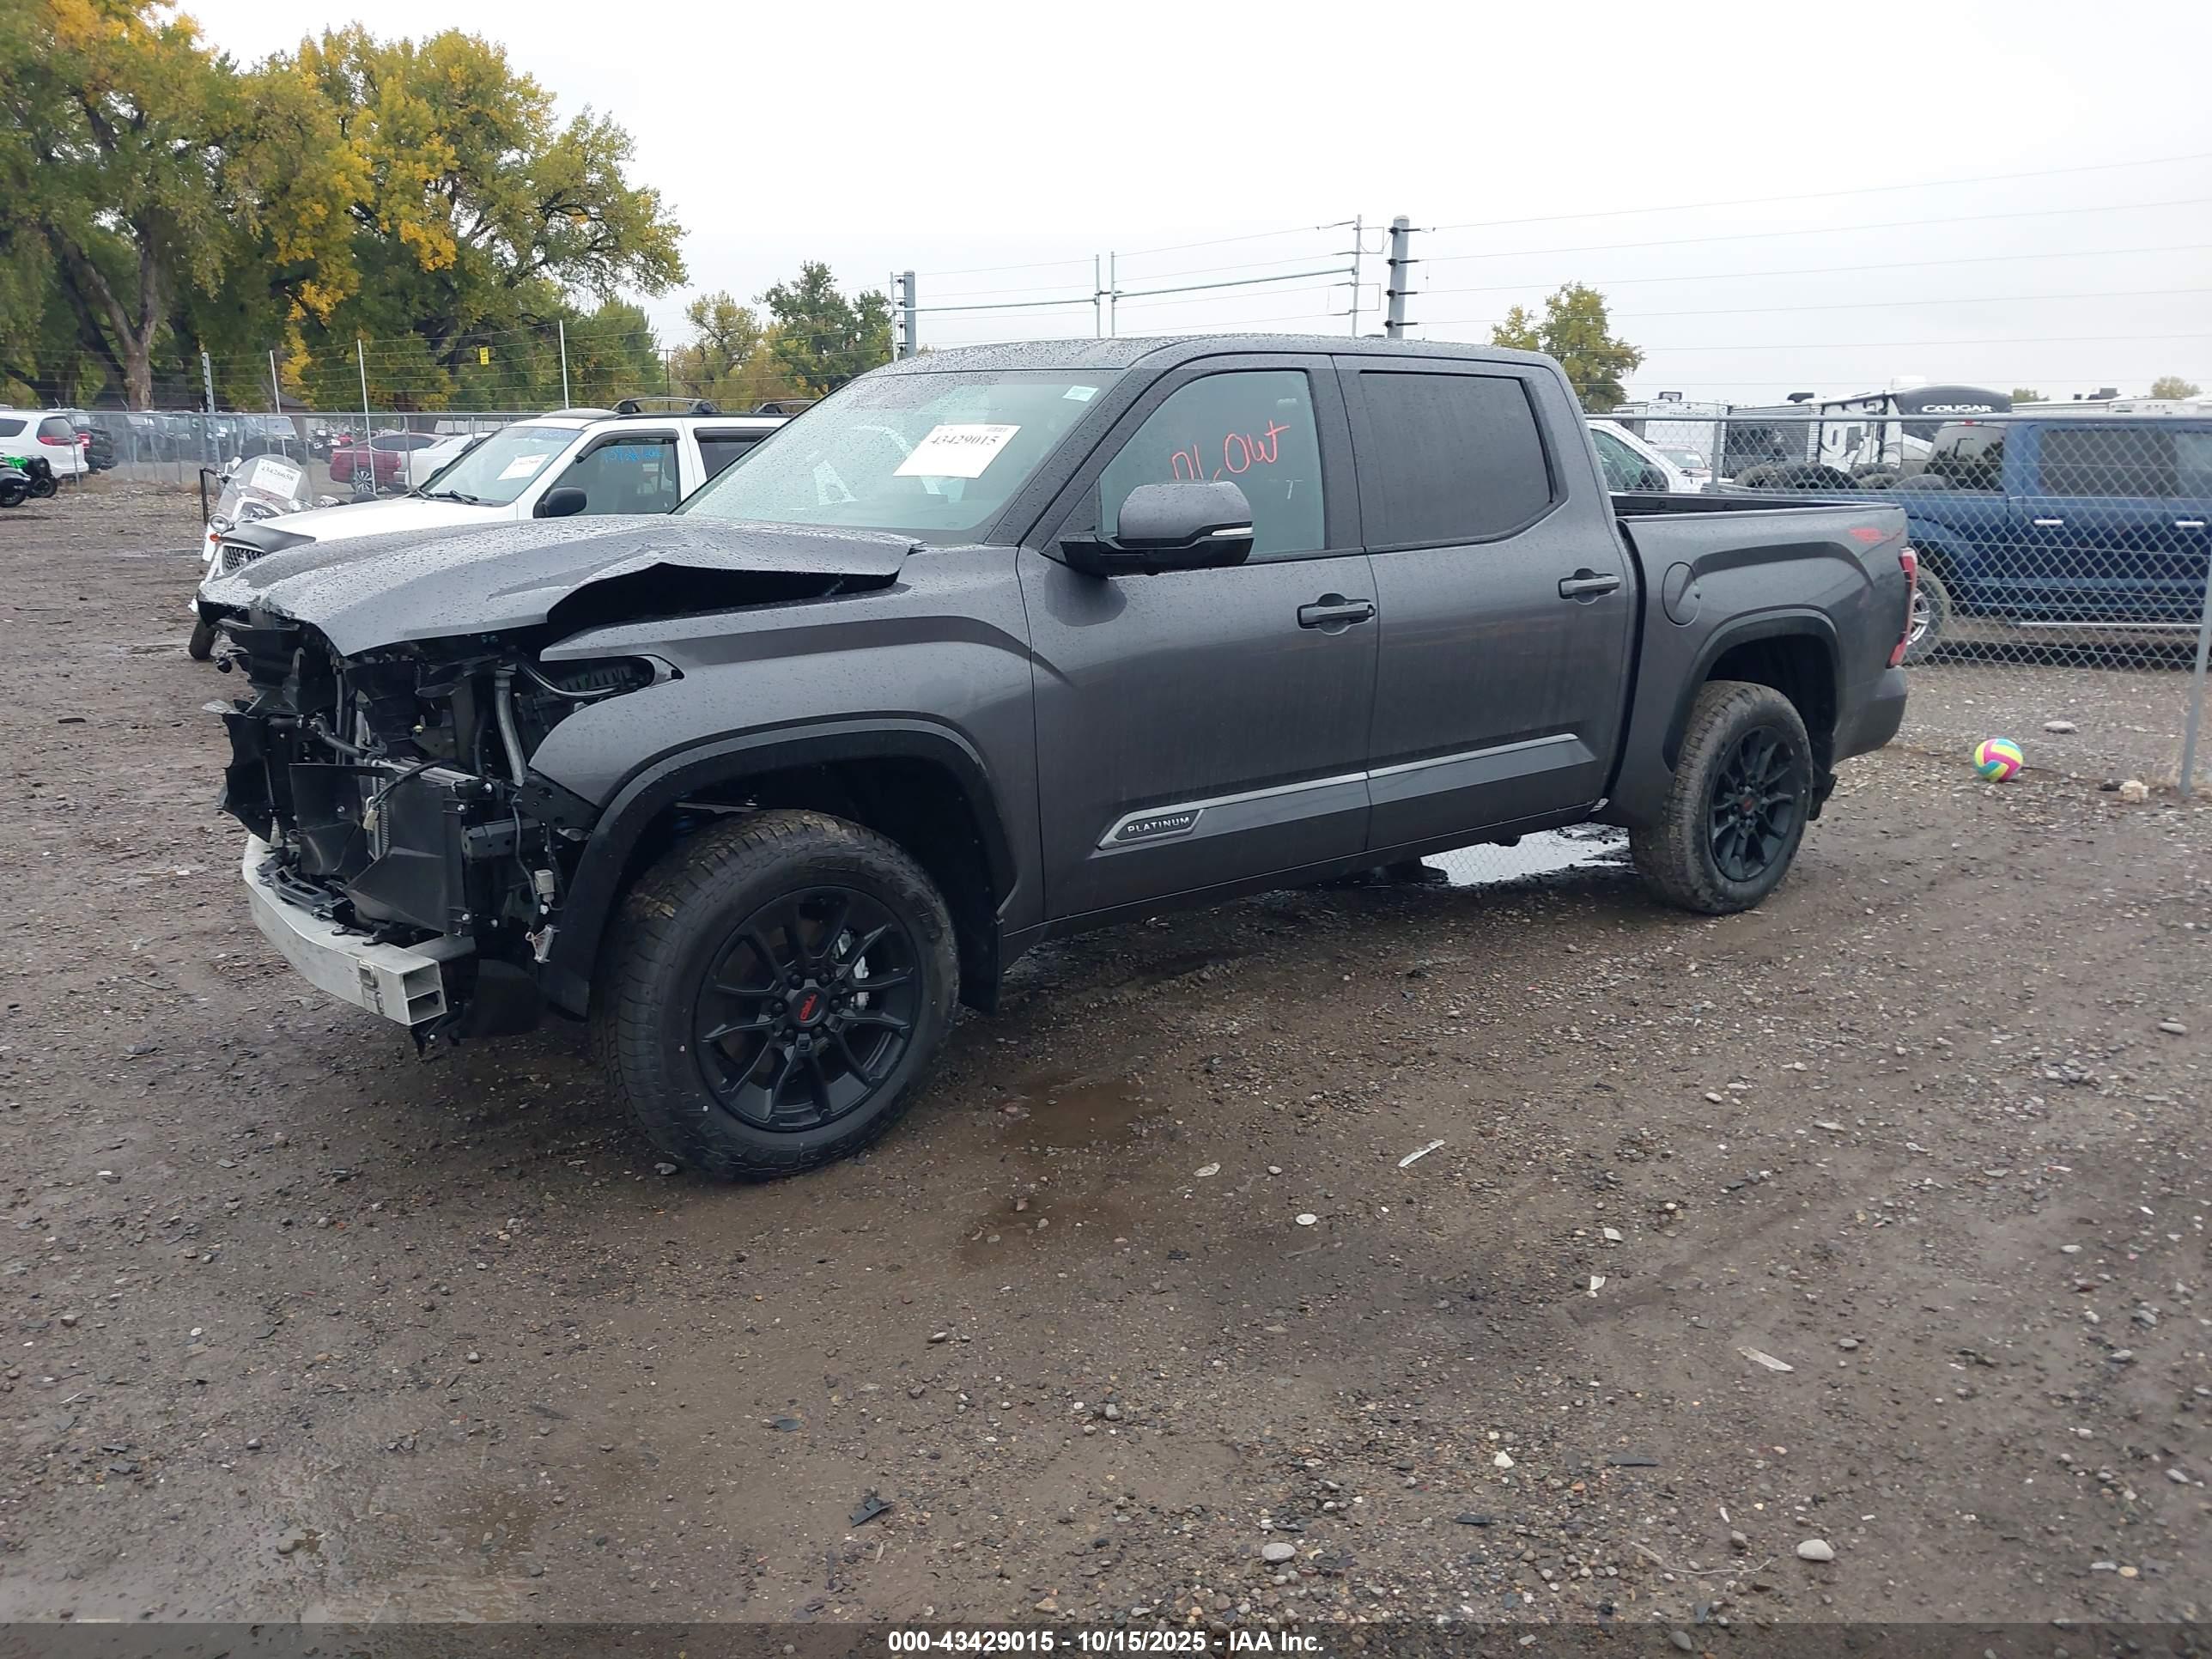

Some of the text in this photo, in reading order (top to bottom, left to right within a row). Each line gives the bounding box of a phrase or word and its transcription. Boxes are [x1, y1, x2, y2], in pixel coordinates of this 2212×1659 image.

[1922, 404, 1993, 413] COUGAR
[931, 435, 1000, 446] 43429015
[1127, 817, 1190, 834] PLATINUM
